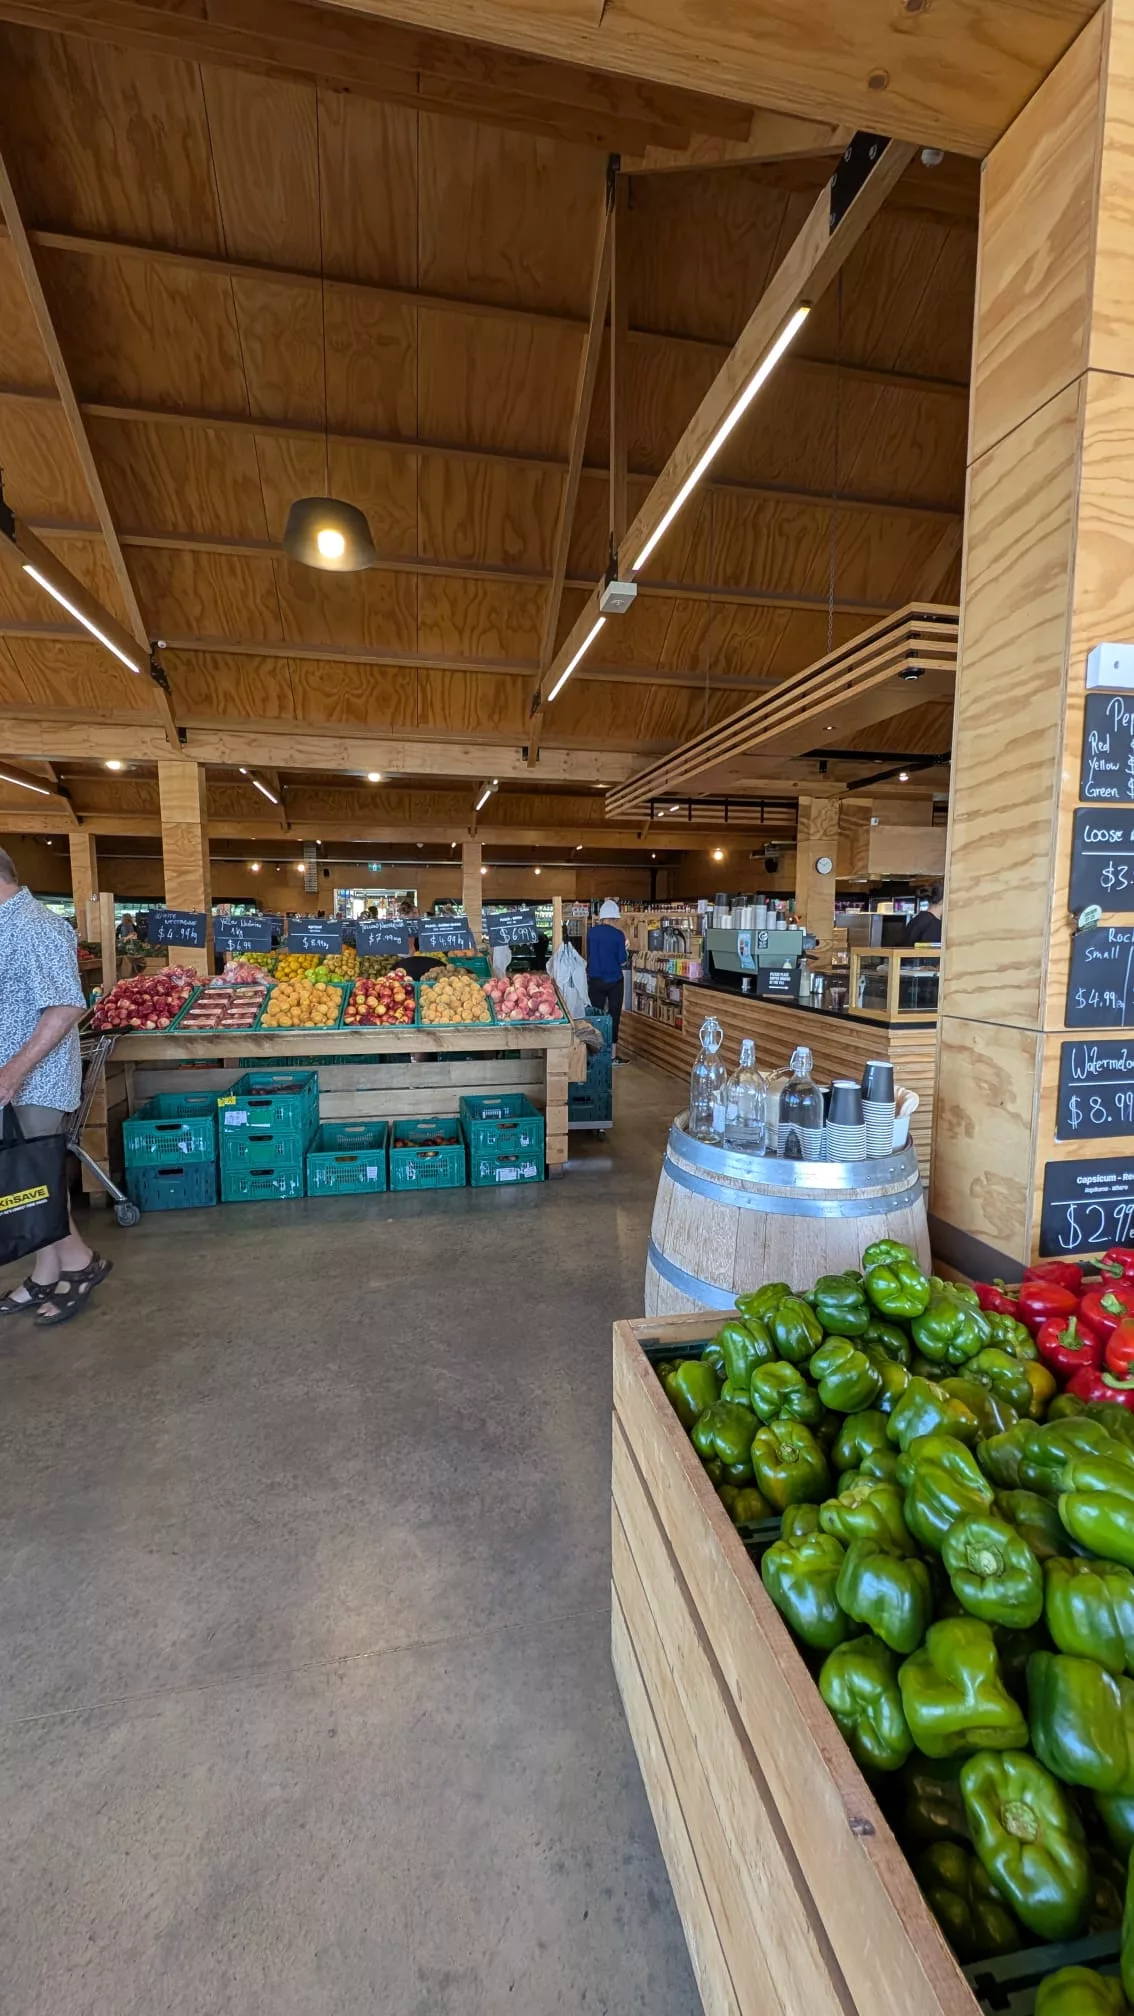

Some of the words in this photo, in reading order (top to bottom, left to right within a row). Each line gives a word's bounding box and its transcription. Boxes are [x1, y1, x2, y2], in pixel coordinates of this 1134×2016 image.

[1088, 730, 1110, 755] Red
[1088, 757, 1120, 782] Yellow
[1085, 780, 1120, 798] Green
[1084, 946, 1120, 962] Small
[1076, 1174, 1117, 1185] Capsicum
